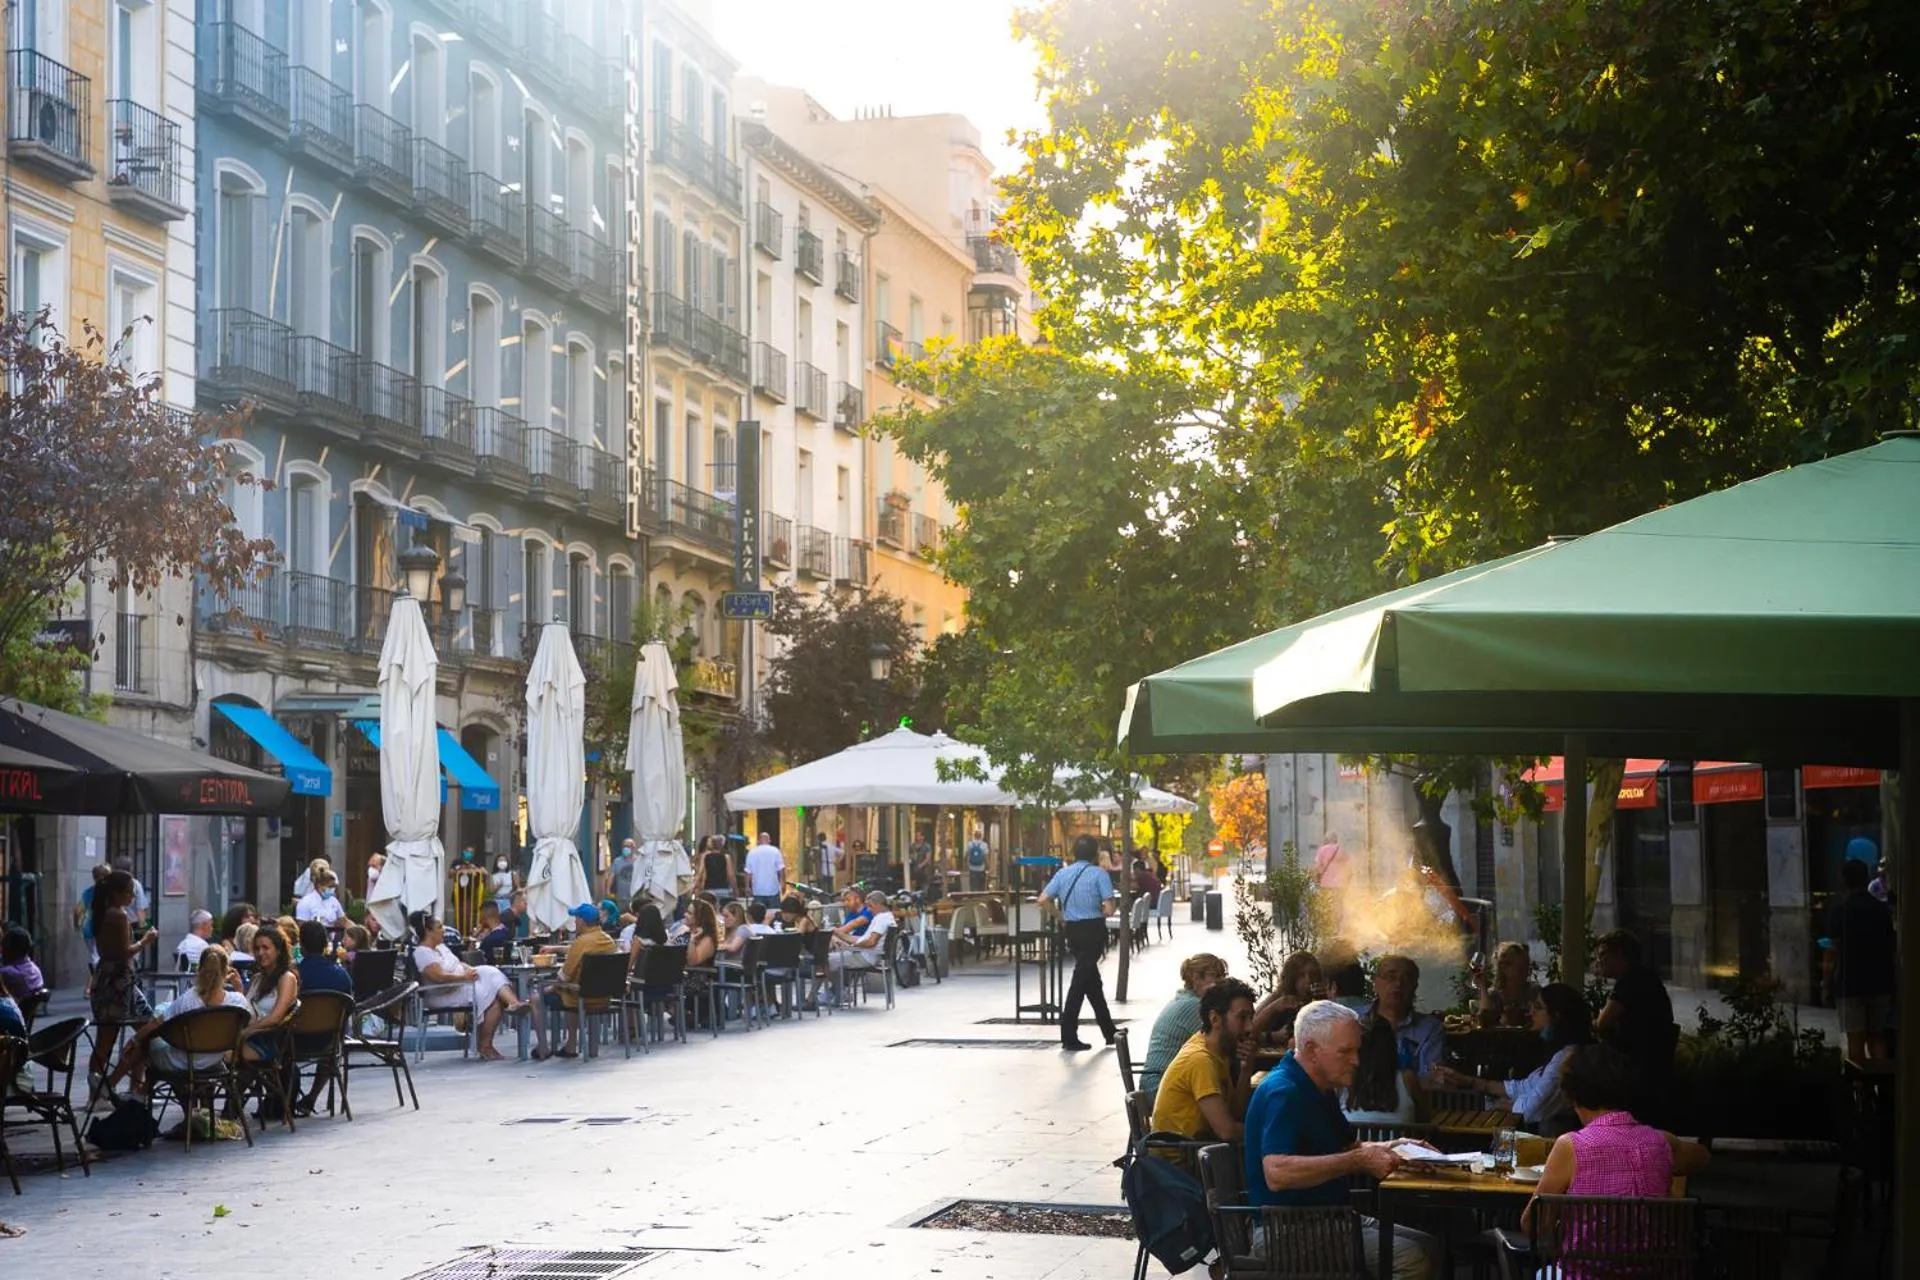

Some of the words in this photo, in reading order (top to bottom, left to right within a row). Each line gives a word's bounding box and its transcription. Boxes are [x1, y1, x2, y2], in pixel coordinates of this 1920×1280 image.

[627, 33, 640, 289] HOSTAL
[627, 314, 641, 535] PERSAL
[742, 516, 753, 583] PLAZA
[200, 778, 253, 805] CENTRAL
